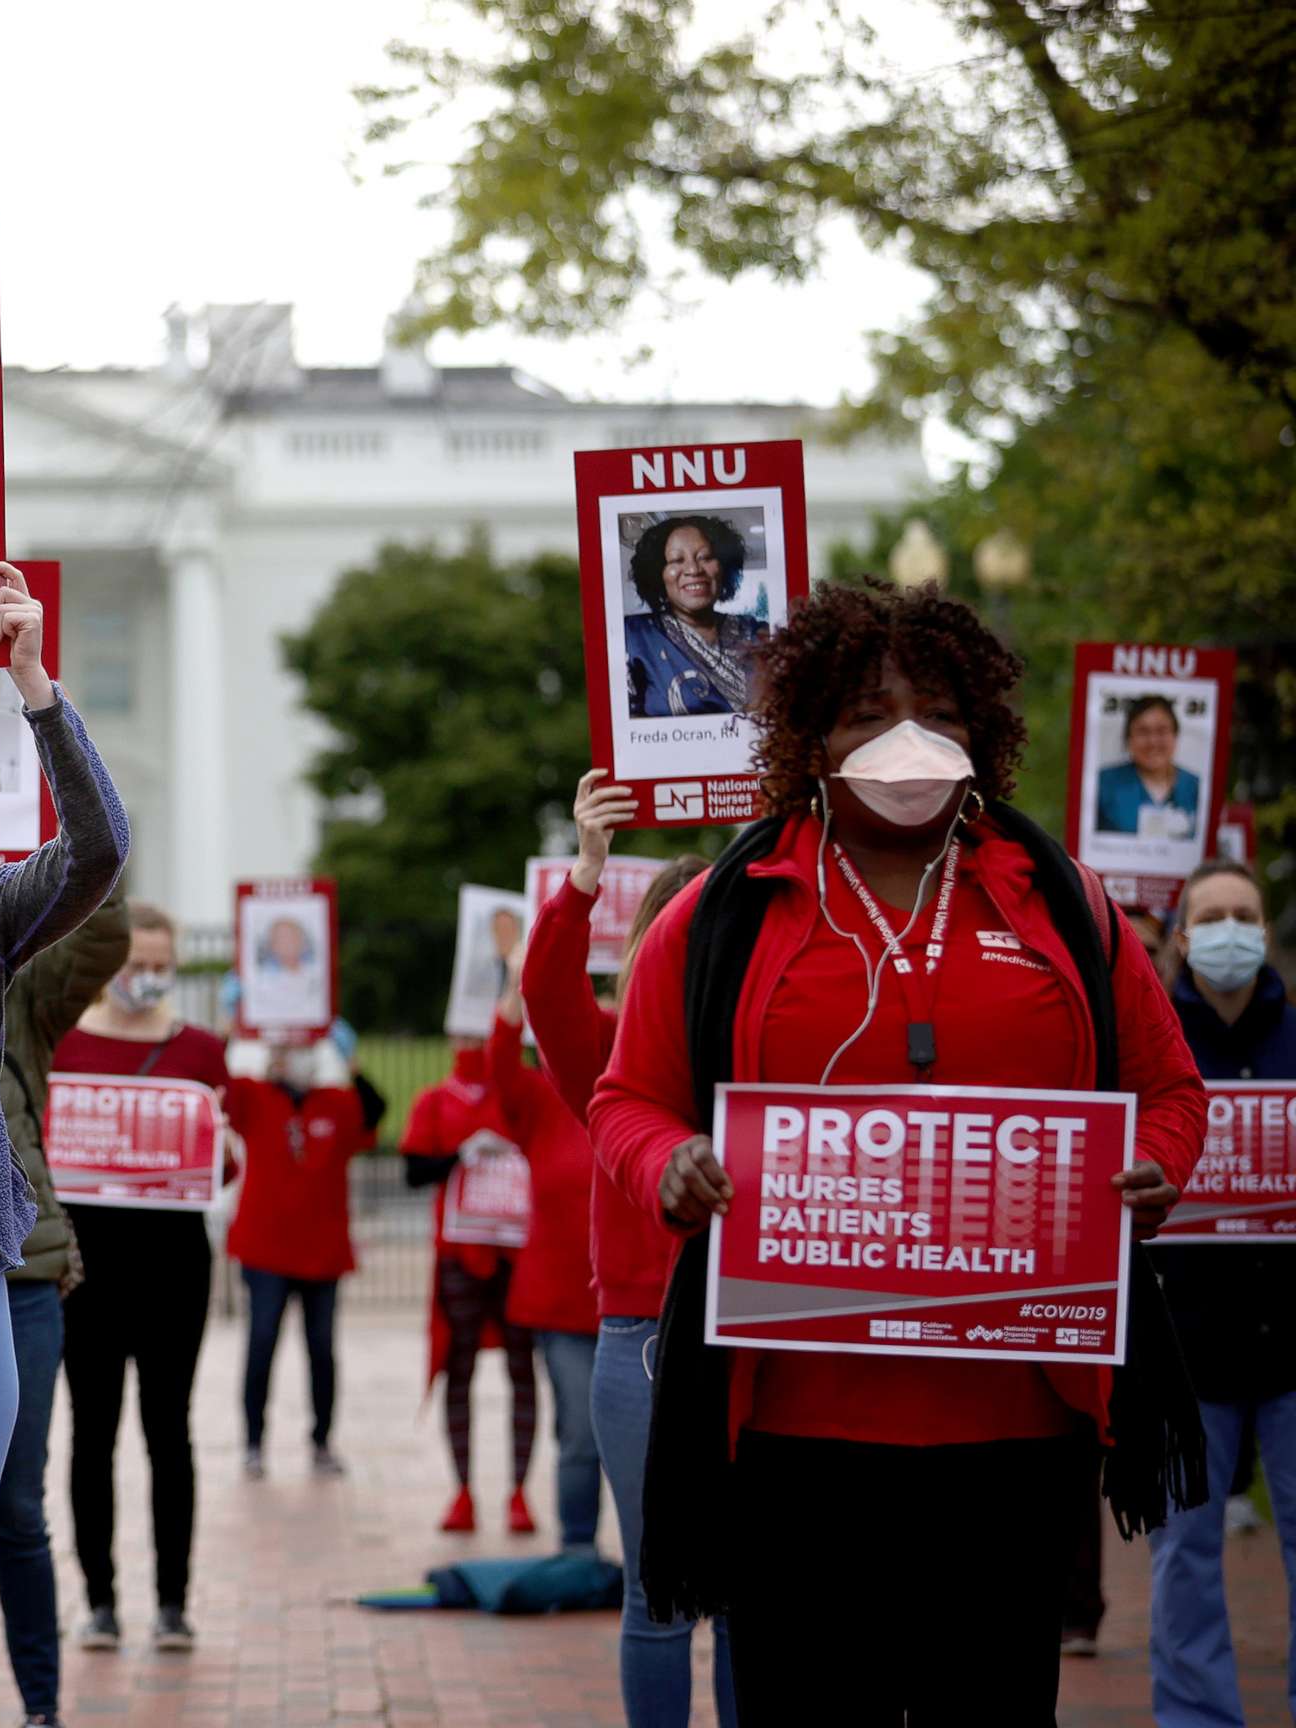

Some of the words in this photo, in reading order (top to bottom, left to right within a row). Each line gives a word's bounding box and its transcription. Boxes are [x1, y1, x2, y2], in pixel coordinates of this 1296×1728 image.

[631, 448, 747, 490] NNU
[1113, 645, 1197, 678] NNU
[630, 730, 668, 744] Freda
[672, 729, 717, 741] Ocran,
[721, 727, 740, 738] RN
[707, 779, 760, 792] National
[708, 793, 753, 805] Nurses
[708, 804, 753, 818] United
[763, 1105, 1086, 1165] PROTECT
[761, 1173, 903, 1203] NURSES
[1231, 1174, 1296, 1192] HEALT
[759, 1206, 932, 1238] PATIENTS
[758, 1238, 885, 1269] PUBLIC
[896, 1243, 1035, 1275] HEALTH
[1019, 1304, 1106, 1320] #COVID19
